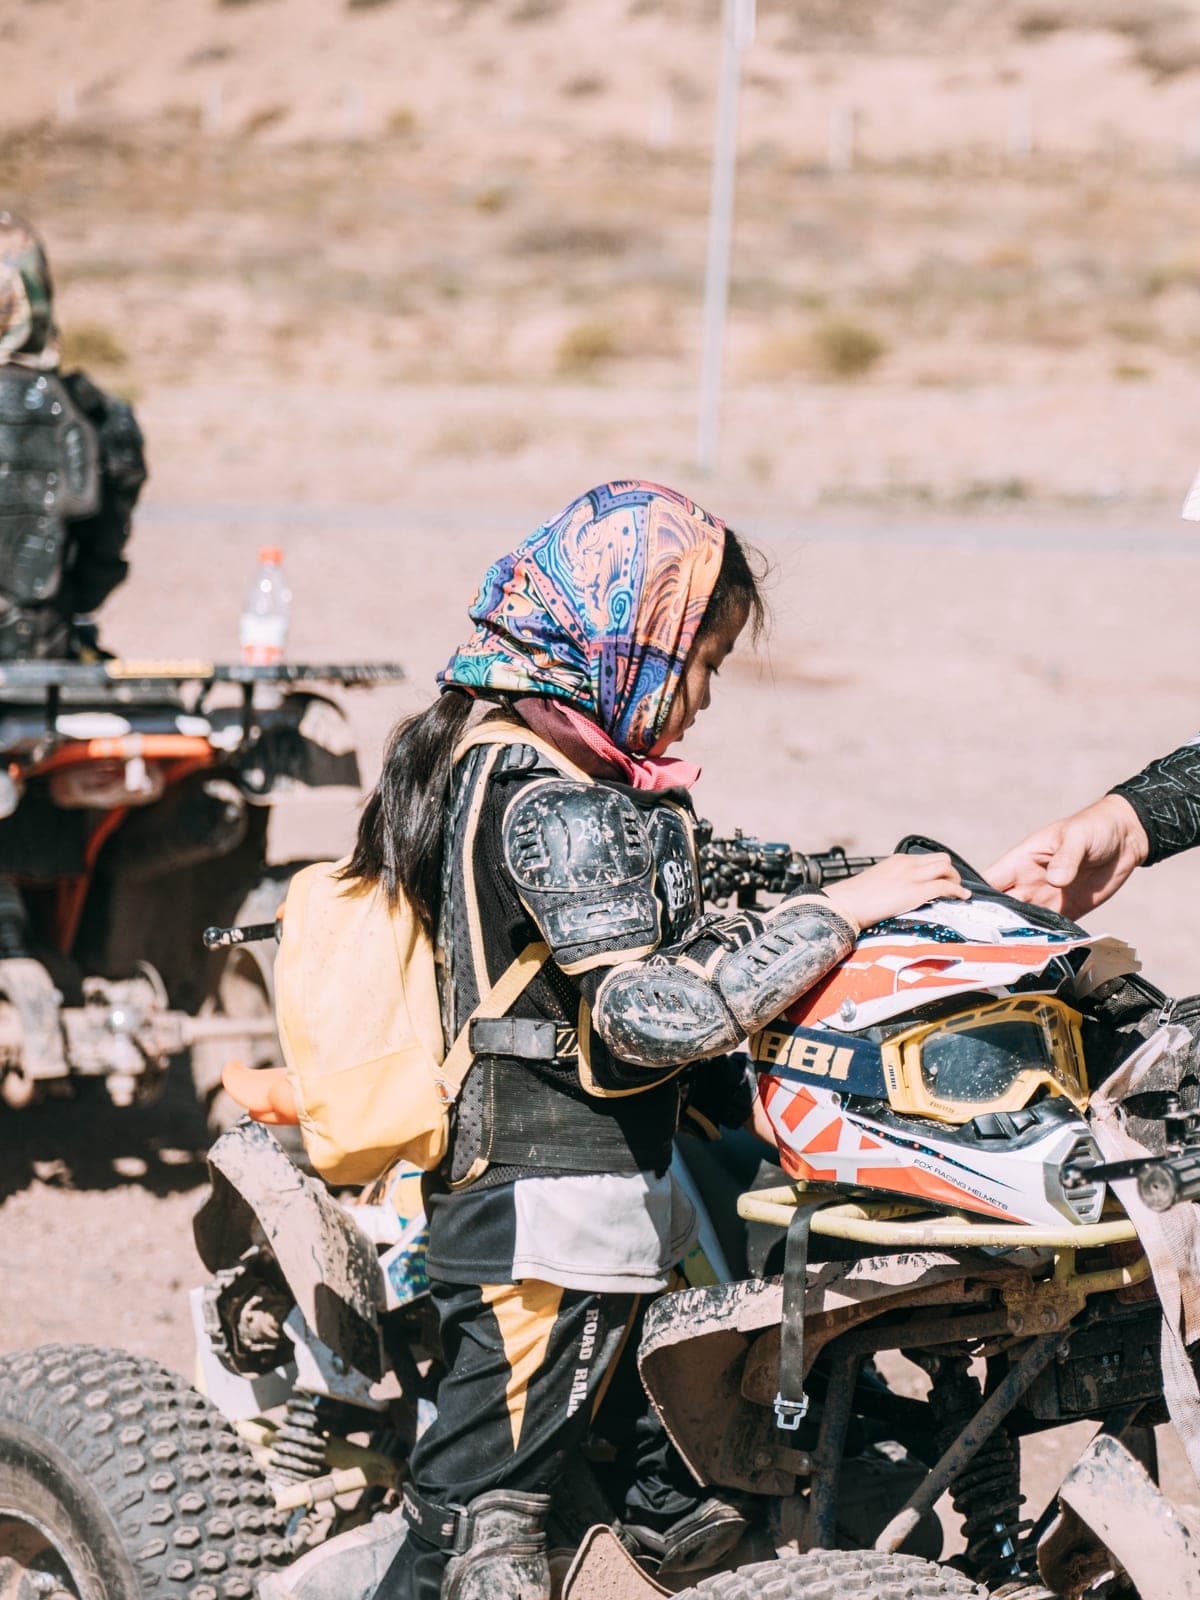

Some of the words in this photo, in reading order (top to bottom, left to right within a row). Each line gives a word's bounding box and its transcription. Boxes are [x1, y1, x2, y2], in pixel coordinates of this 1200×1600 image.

[914, 1158, 934, 1171] FOX
[934, 1167, 967, 1191] RACING
[579, 1309, 599, 1360] ROAD
